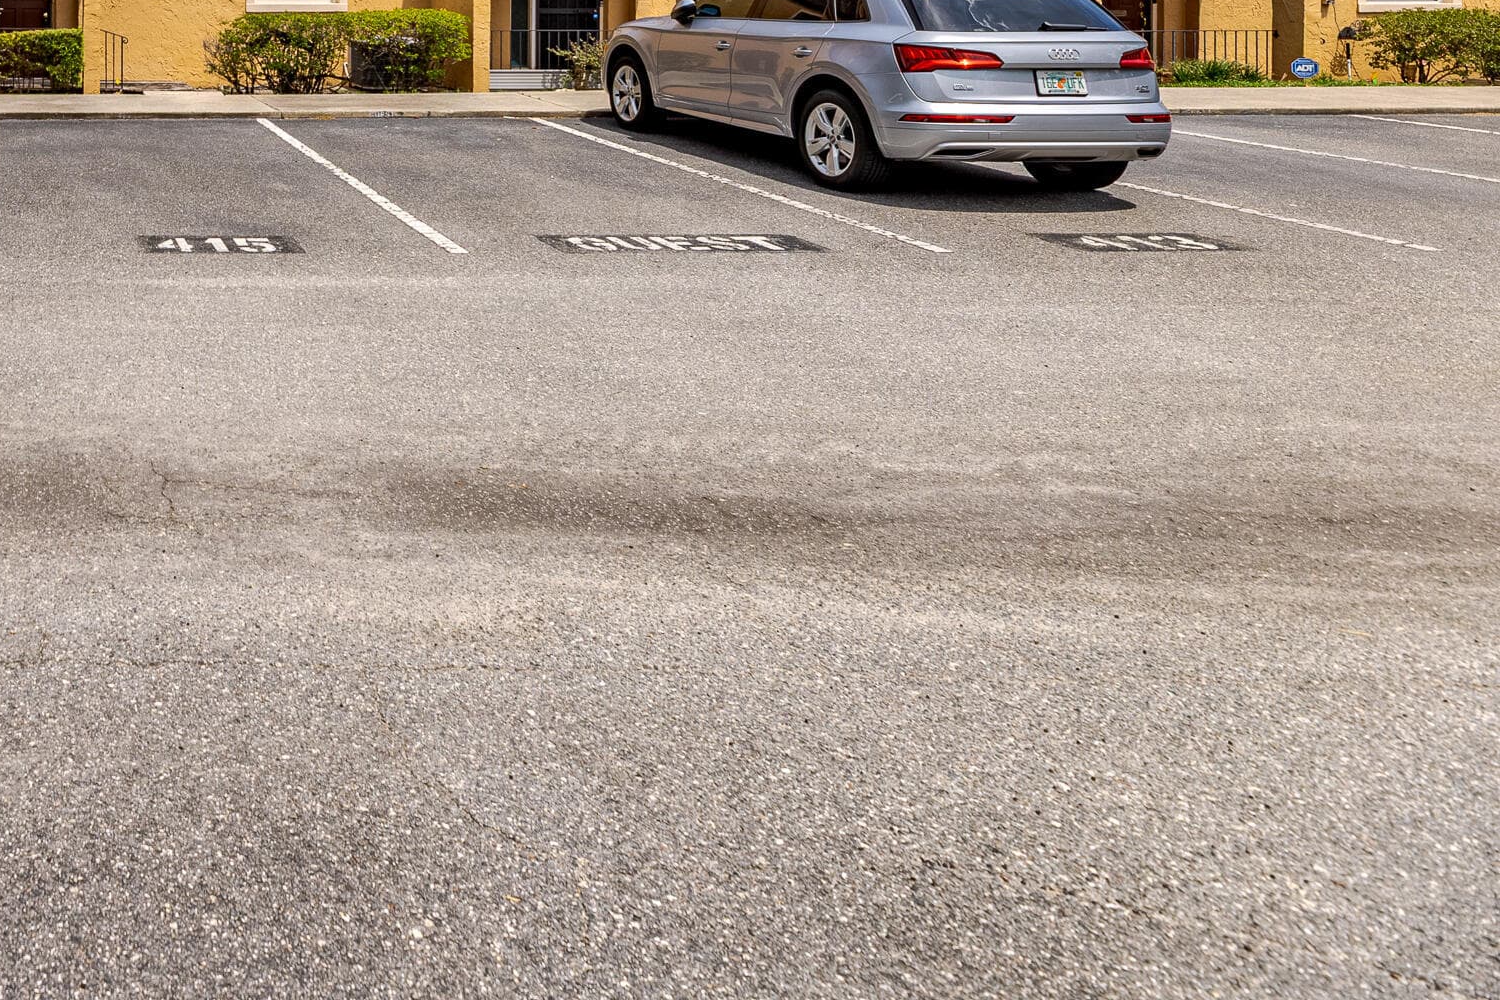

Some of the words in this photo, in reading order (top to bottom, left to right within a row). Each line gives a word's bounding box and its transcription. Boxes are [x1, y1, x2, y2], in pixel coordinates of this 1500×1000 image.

[1296, 64, 1314, 72] ADT
[157, 237, 277, 253] 415
[567, 236, 786, 251] GUEST
[1080, 234, 1219, 250] 413
